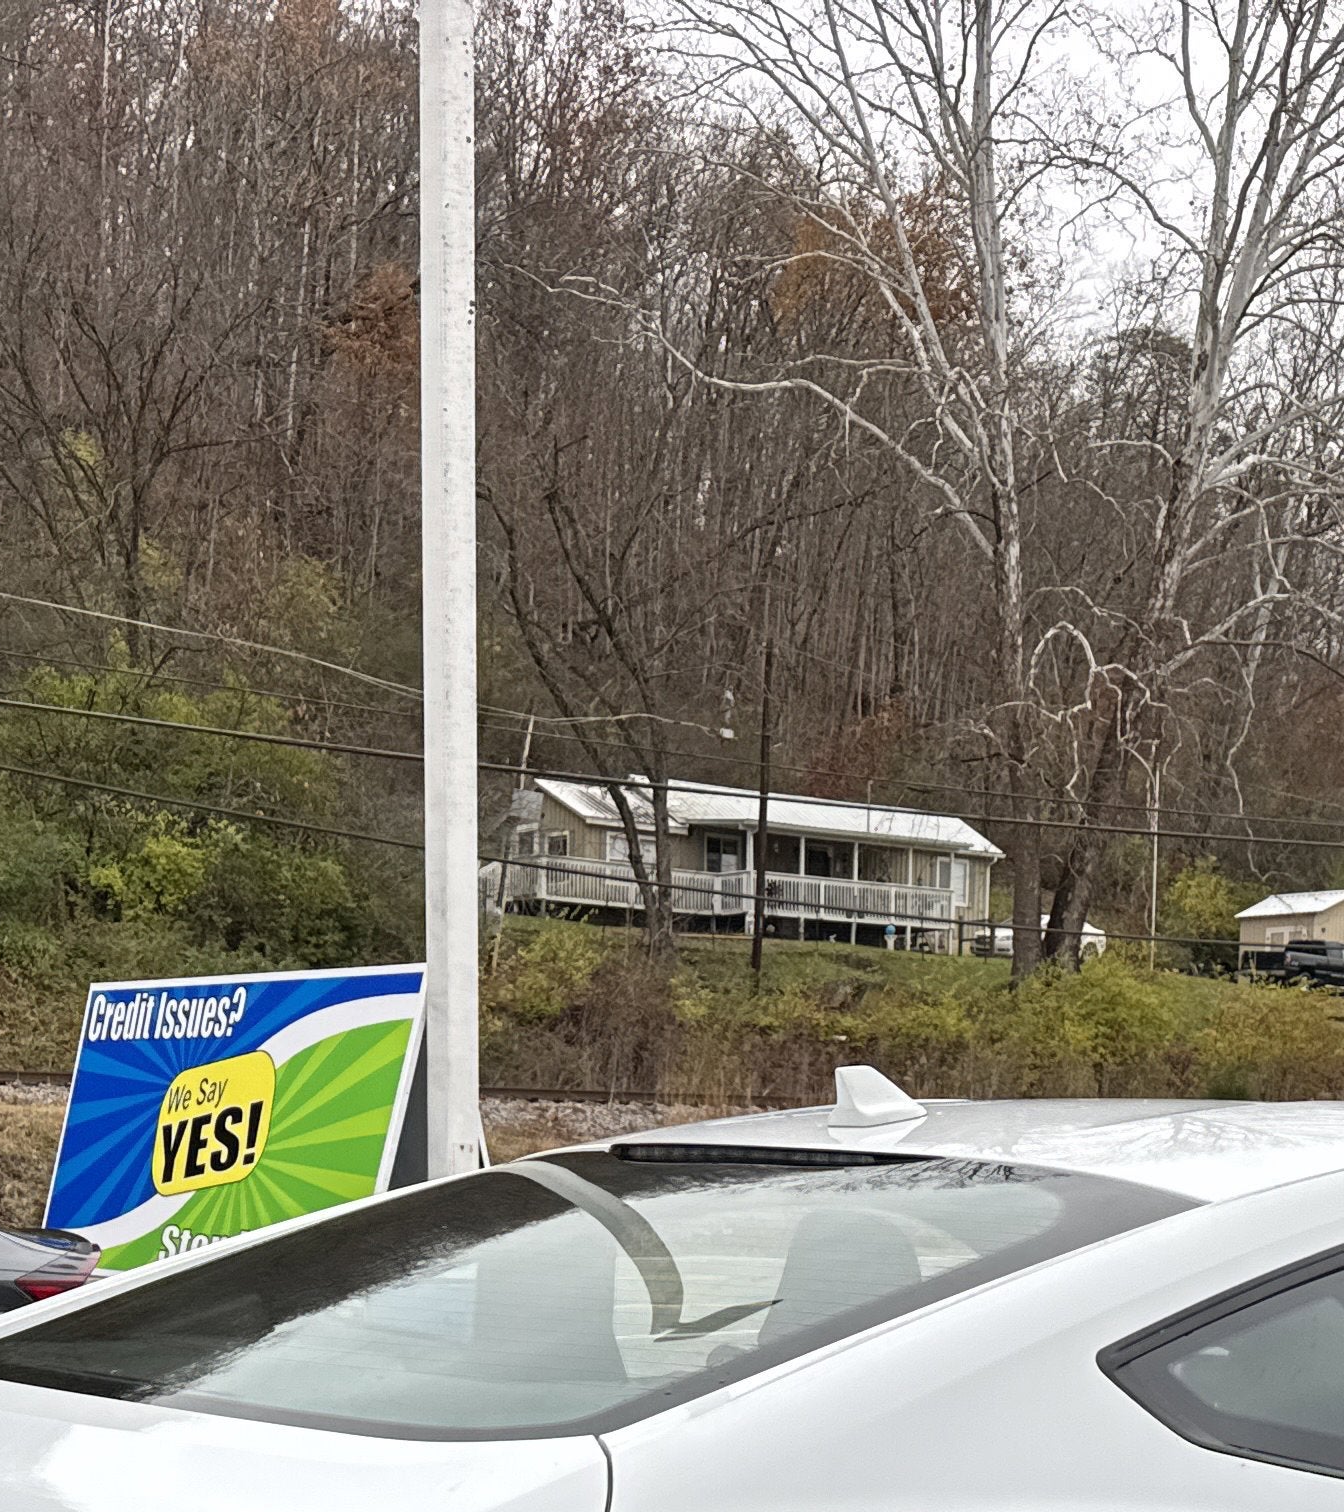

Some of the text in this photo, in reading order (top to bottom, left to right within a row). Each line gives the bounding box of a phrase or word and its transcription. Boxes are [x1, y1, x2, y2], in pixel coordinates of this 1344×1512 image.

[88, 986, 247, 1042] Credit Issues?
[167, 1077, 228, 1114] We Say
[161, 1101, 264, 1184] YES!
